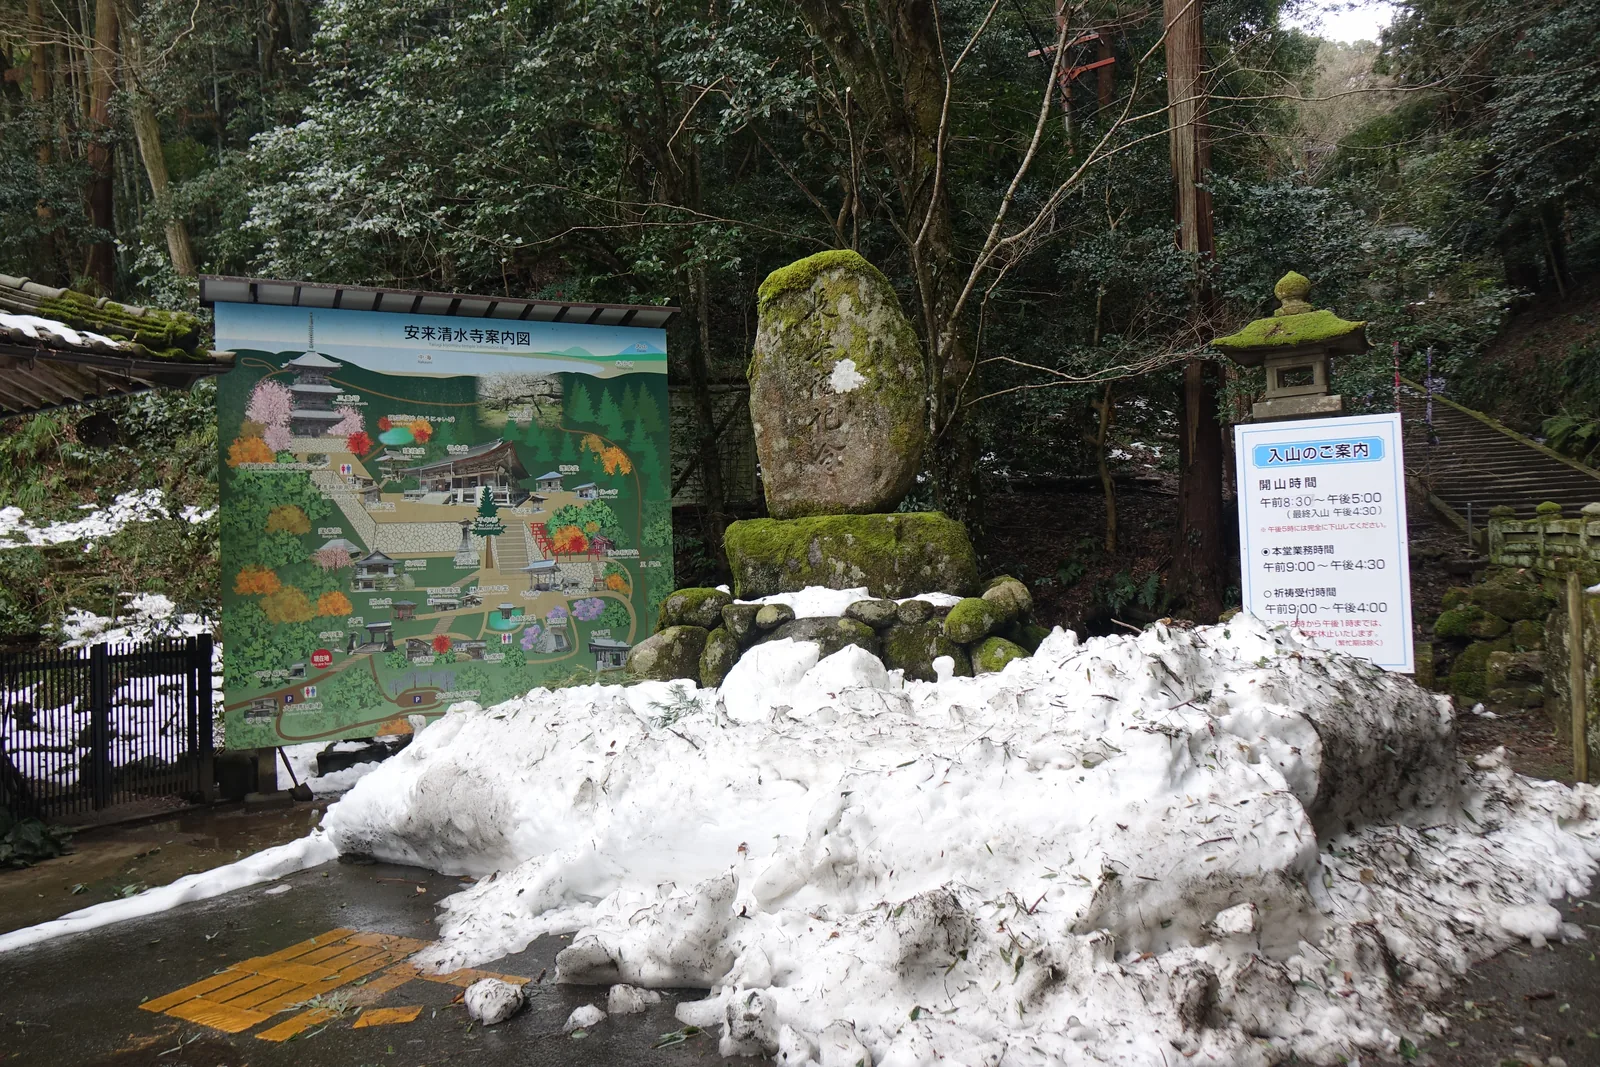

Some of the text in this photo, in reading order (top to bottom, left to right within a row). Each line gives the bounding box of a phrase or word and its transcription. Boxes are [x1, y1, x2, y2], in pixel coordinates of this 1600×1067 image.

[404, 324, 531, 346] 安来清水寺案内図
[1268, 442, 1369, 463] 入山のご案内
[1259, 476, 1317, 491] 開山時間
